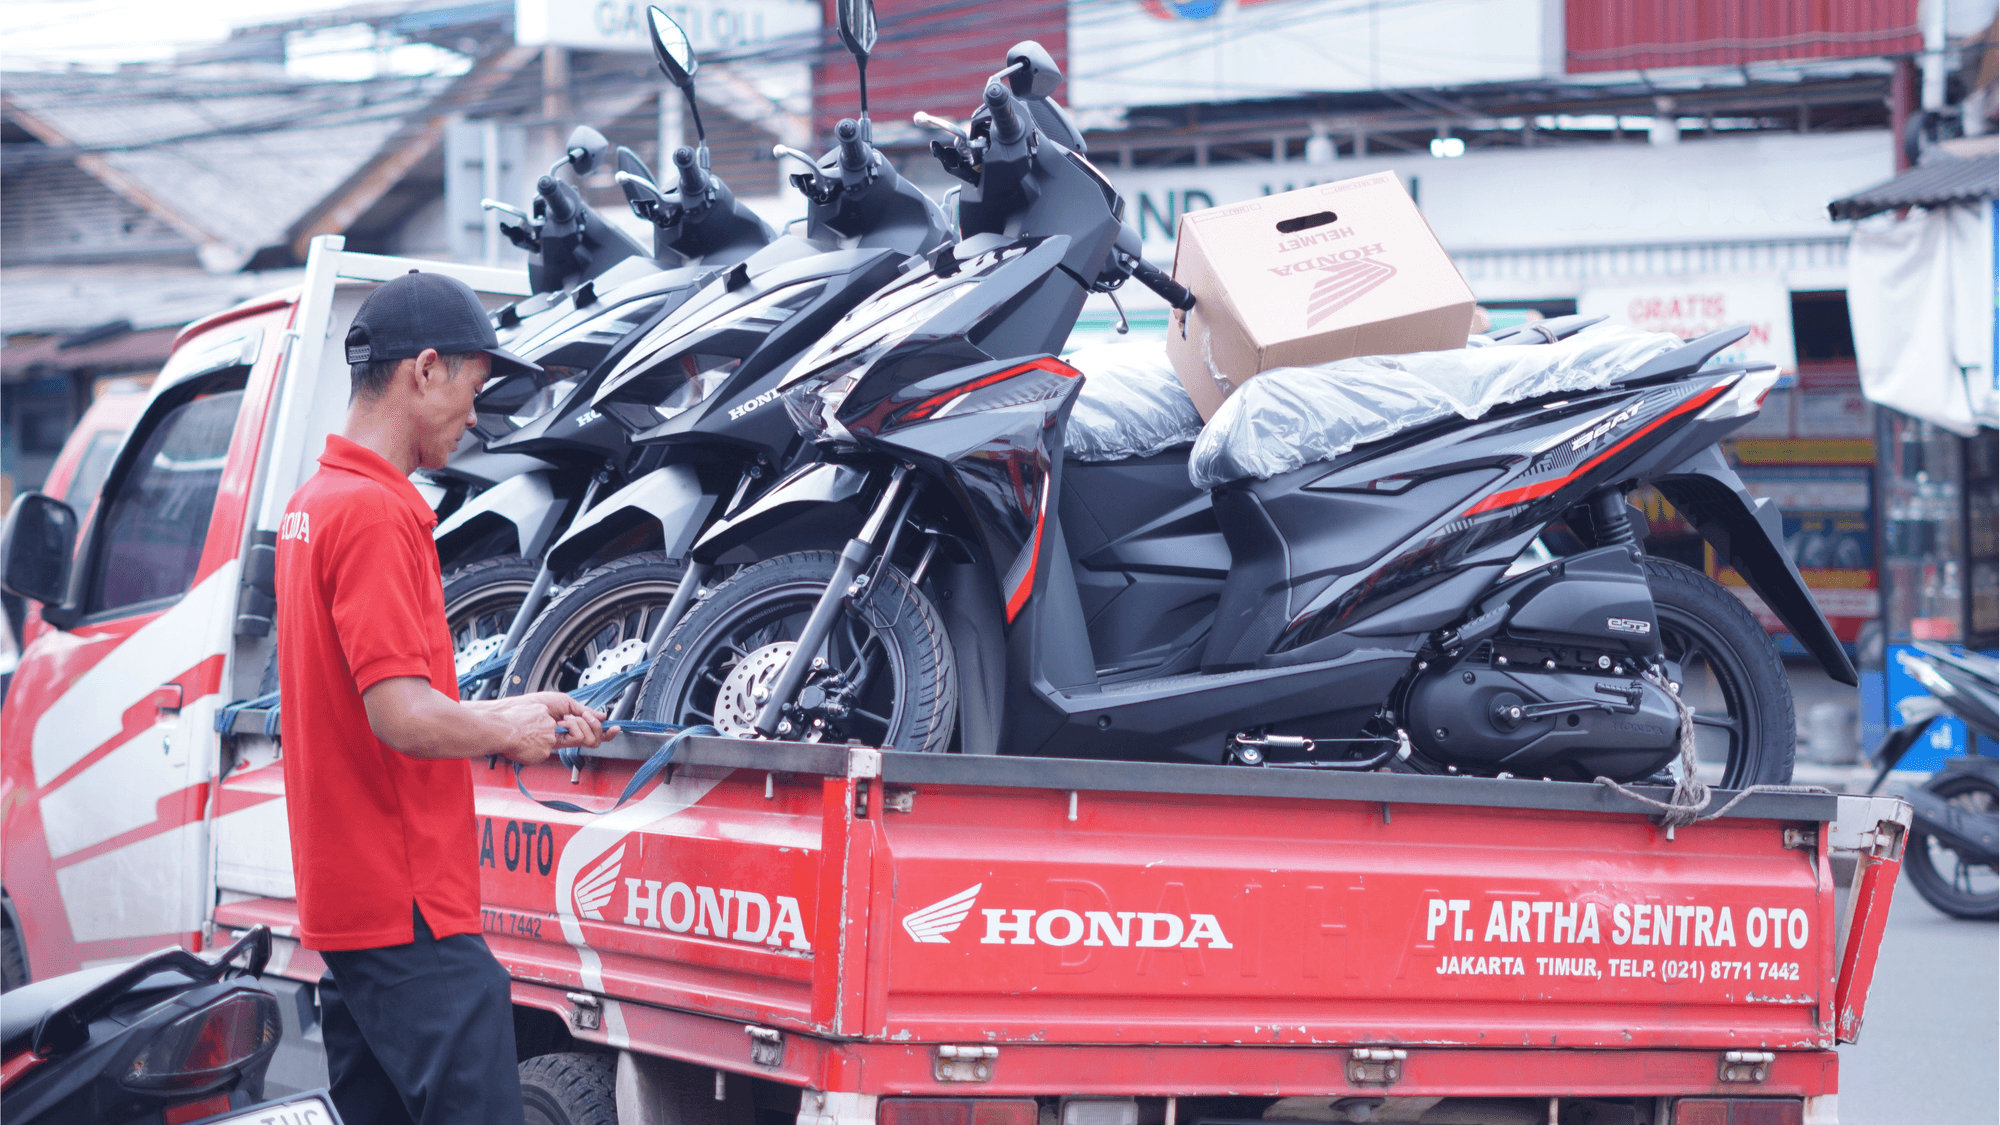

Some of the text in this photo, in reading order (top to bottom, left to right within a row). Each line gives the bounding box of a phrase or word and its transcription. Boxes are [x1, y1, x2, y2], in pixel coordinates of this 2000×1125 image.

[595, 1, 704, 43] GATI
[1278, 226, 1355, 253] HELMET
[1267, 242, 1387, 277] HONDA
[728, 388, 781, 421] HON
[1613, 721, 1665, 736] HONDA
[503, 820, 554, 876] OTO
[481, 909, 542, 938] 771 7442
[623, 877, 812, 950] HONDA
[980, 908, 1234, 949] HONDA
[1426, 899, 1809, 949] PT. ARTHA SENTRA OTO
[1435, 956, 1800, 984] JAKARTA TIMUR, TELP. (021) 8771 7442
